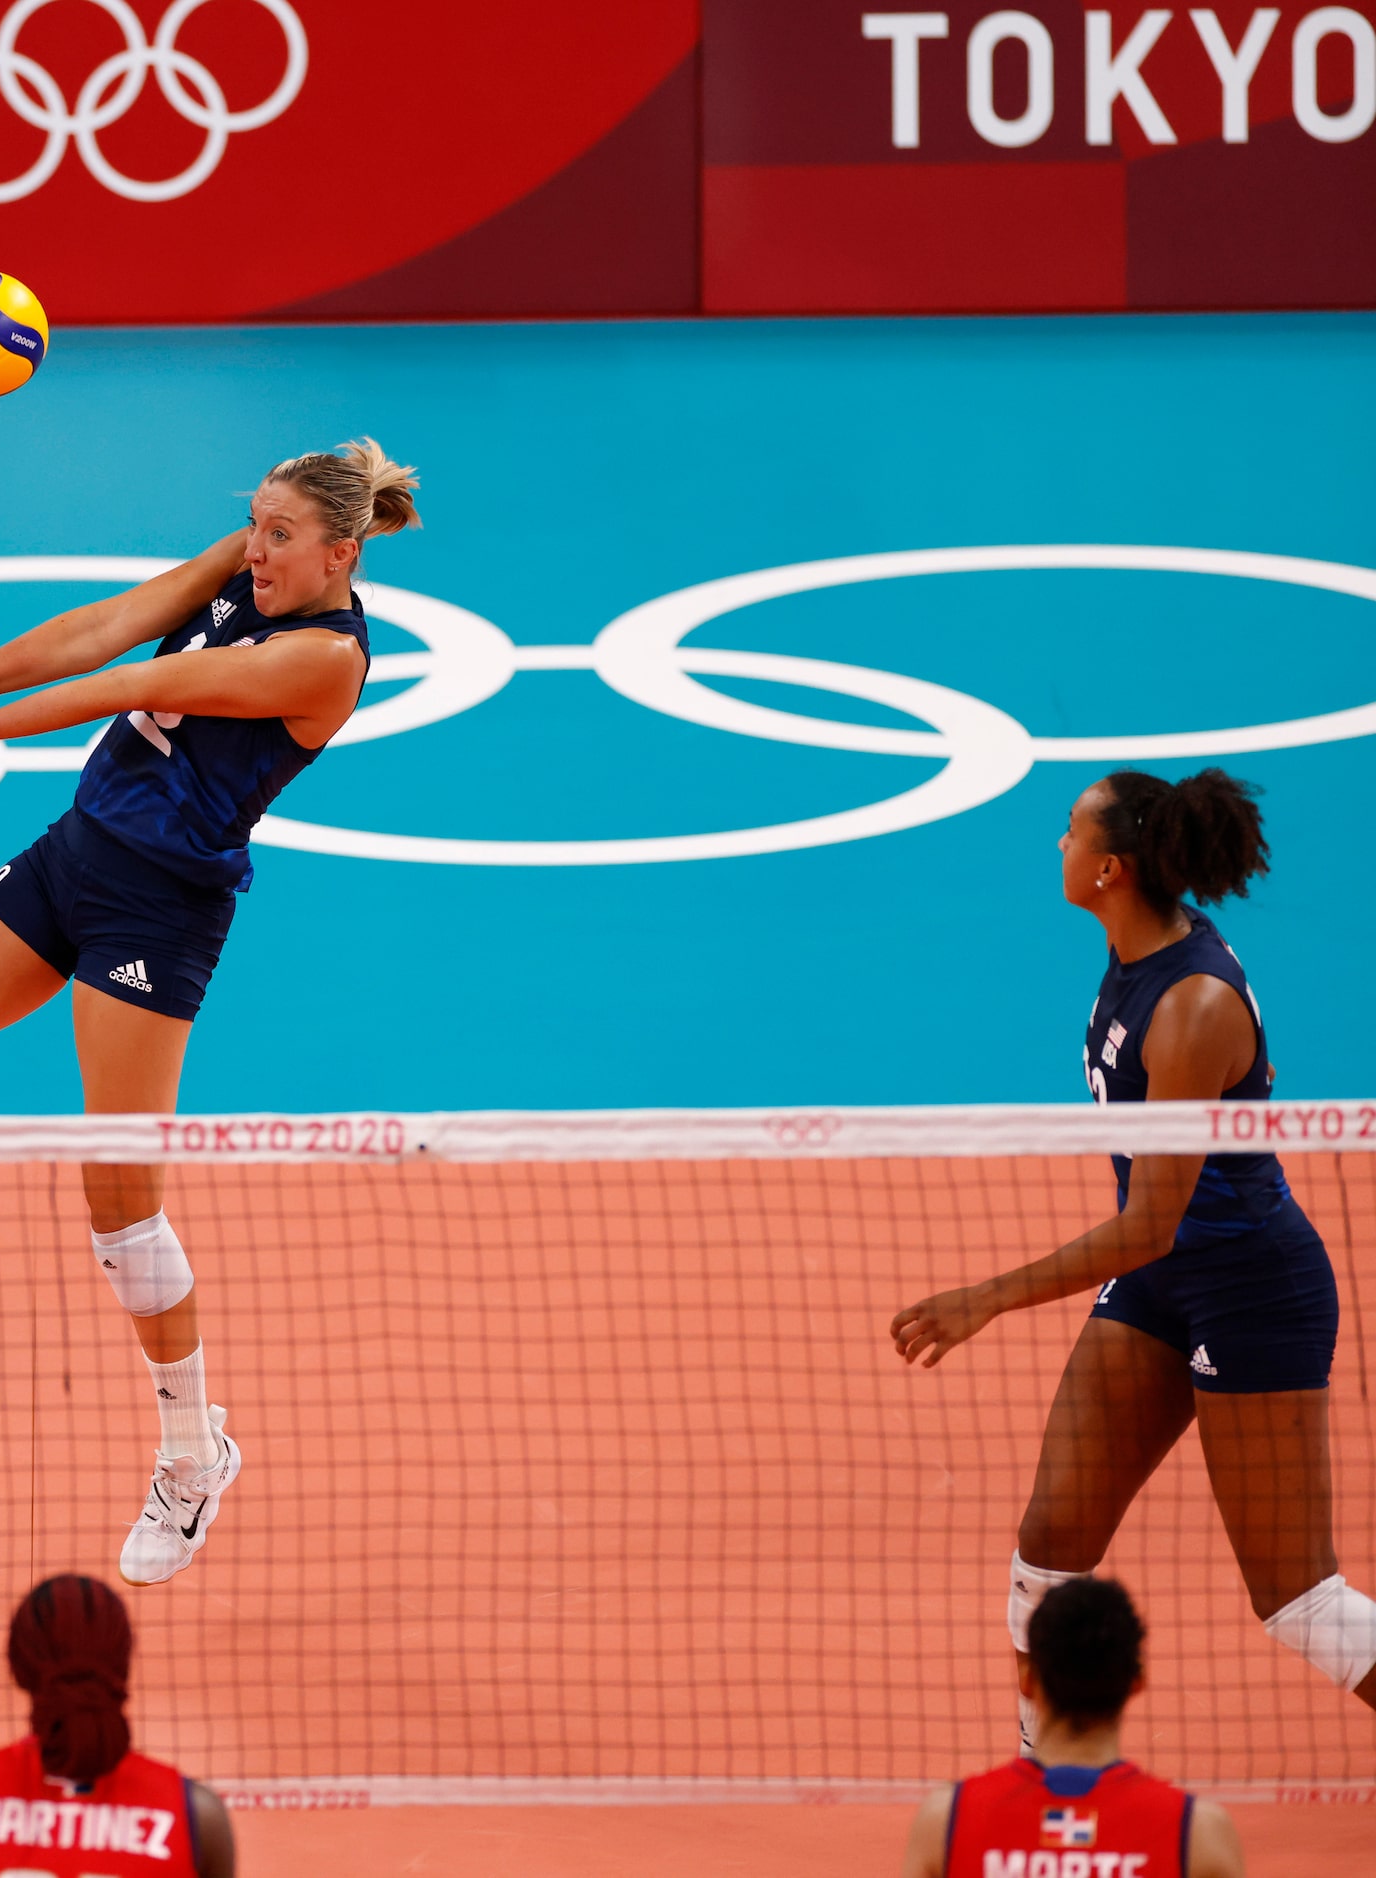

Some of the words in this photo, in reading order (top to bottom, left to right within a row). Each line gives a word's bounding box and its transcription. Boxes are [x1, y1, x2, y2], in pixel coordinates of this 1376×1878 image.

[861, 6, 1376, 148] TOKYO
[10, 331, 37, 350] V200W
[211, 599, 223, 629] adida
[108, 970, 153, 993] adidas
[157, 1121, 293, 1152] TOKYO
[305, 1119, 405, 1155] 2020
[1204, 1107, 1344, 1141] TOKYO
